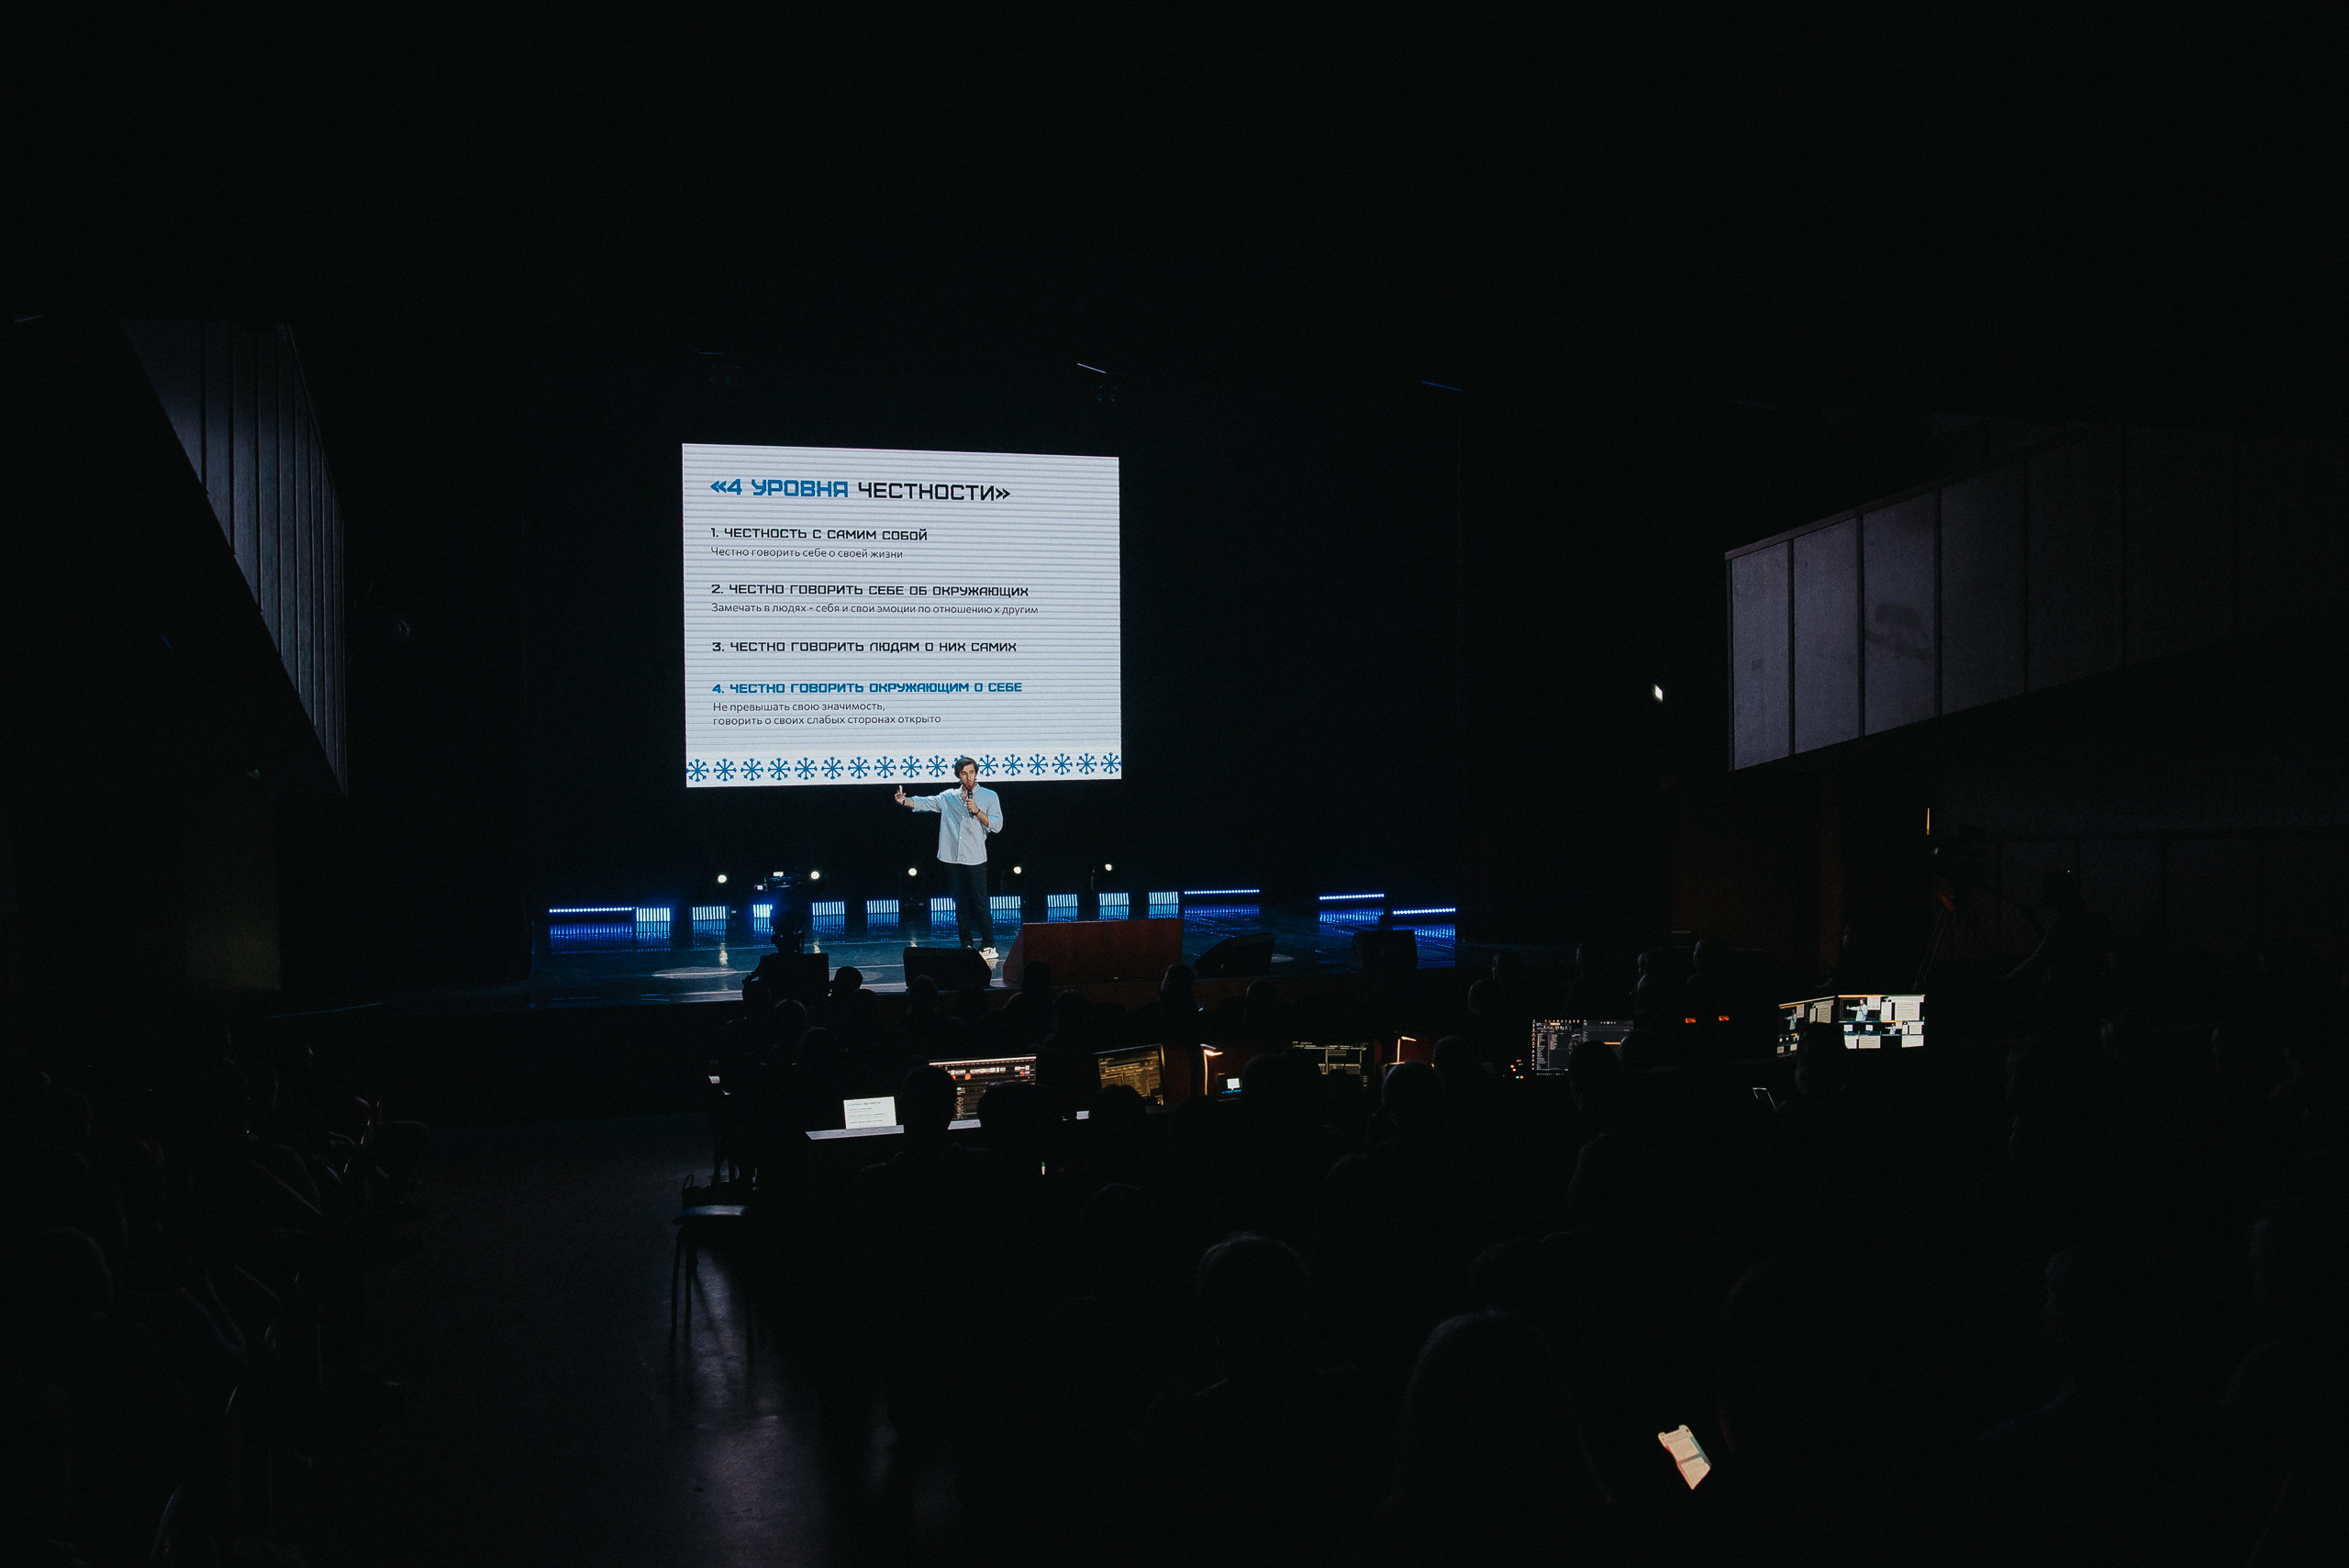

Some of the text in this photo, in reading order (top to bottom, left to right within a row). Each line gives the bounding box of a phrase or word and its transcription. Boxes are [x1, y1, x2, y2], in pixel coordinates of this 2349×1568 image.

[710, 479, 1011, 501] «4 УРОВНЯ ЧЕСТНОСТИ»
[711, 528, 928, 541] 1. ЧЕСТНОСТЬ С САМИМ СОБОЙ
[711, 547, 750, 557] Честно
[751, 549, 801, 559] говорить
[802, 548, 827, 558] себе
[838, 549, 868, 559] своей
[870, 550, 903, 559] жизни
[711, 584, 1029, 598] 2. ЧЕСТНО ГОВОРИТЬ СЕБЕ ОБ ОКРУЖАЮЩИХ
[711, 603, 763, 613] Замечать
[772, 606, 807, 615] людях
[816, 603, 841, 613] себя
[851, 606, 875, 614] свои
[877, 606, 917, 616] эмоции
[932, 606, 993, 615] отношению
[995, 606, 1000, 615] к
[1001, 606, 1039, 617] другим
[712, 642, 1017, 653] 3. ЧЕСТНО ГОВОРИТЬ ЛЮДЯМ О НИХ САМИХ
[712, 683, 1023, 695] 4. ЧЕСТНО ГОВОРИТЬ ОКРУЖАЮЩИМ О СЕБЕ
[713, 702, 885, 715] Не превышать свою значимость,
[713, 717, 763, 728] говорить
[774, 717, 805, 725] своих
[807, 715, 845, 725] слабых
[847, 717, 896, 726] сторонах
[898, 716, 941, 726] открыто
